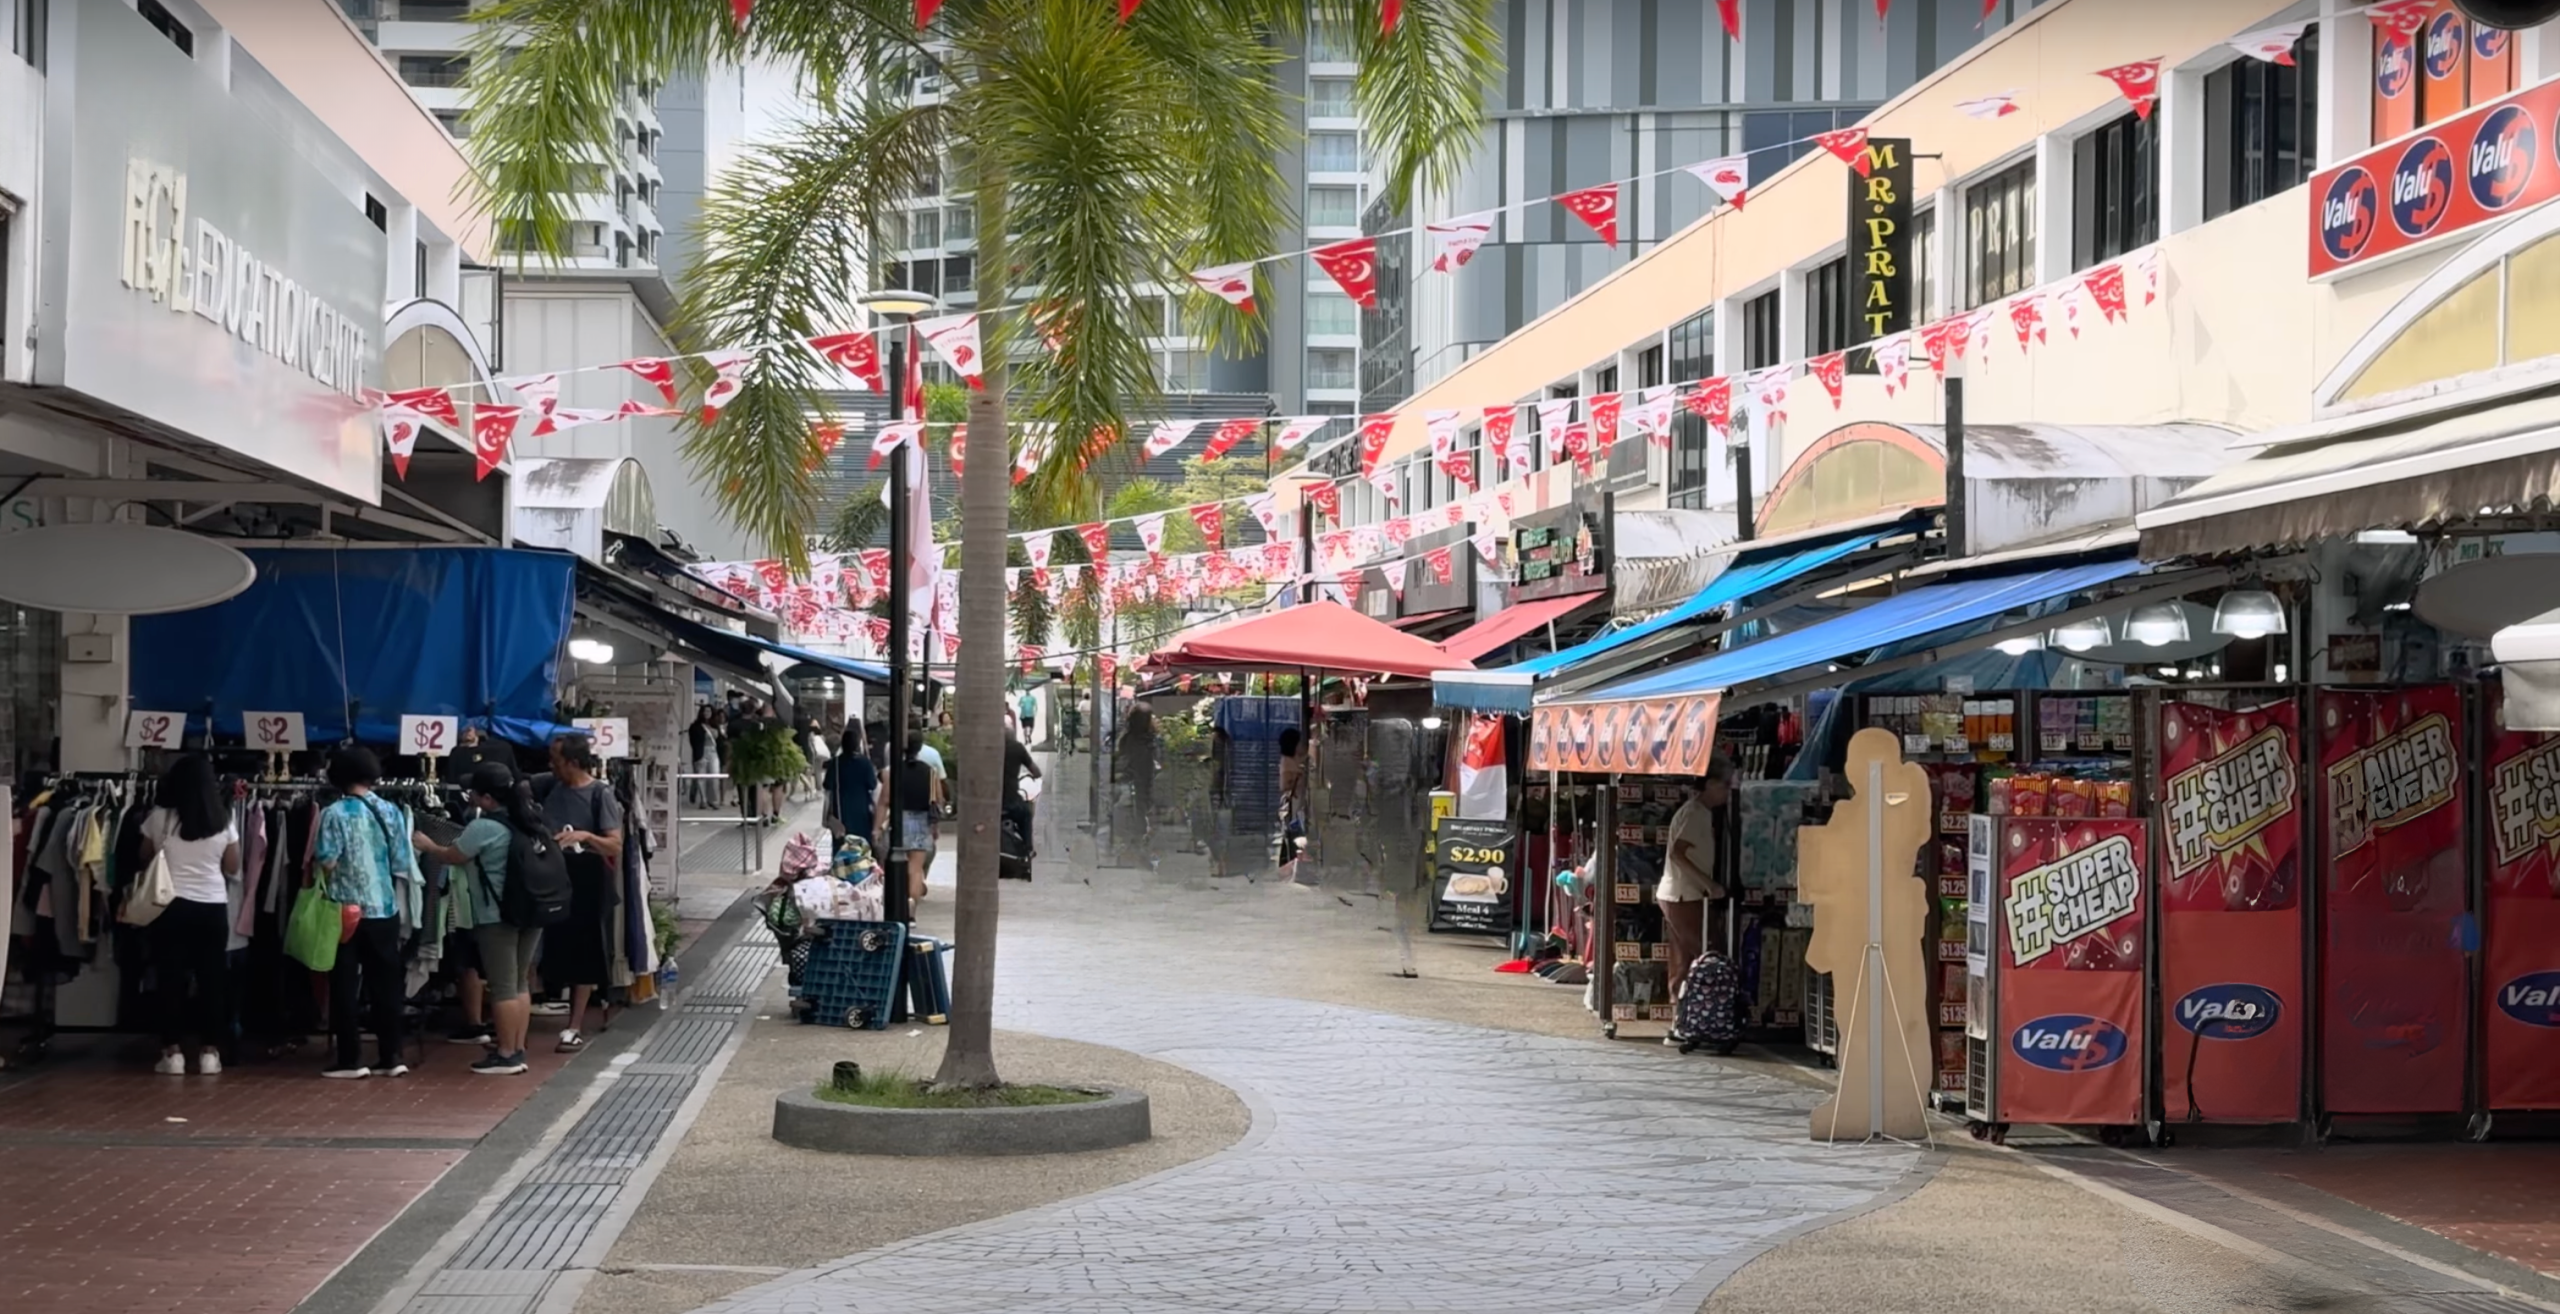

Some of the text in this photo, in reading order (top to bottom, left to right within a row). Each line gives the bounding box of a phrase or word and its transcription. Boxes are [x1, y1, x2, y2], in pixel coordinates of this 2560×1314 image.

[139, 715, 171, 744] $2
[257, 716, 290, 745] $2
[414, 720, 444, 749] $2
[2207, 770, 2288, 834] CHEAP
[1942, 814, 1968, 830] $2.25
[1451, 845, 1506, 864] $2.90
[1941, 879, 1967, 894] $1.25
[1456, 903, 1481, 914] Meal
[2051, 872, 2135, 938] CHEAP
[1941, 942, 1967, 958] $1.35
[1942, 1006, 1967, 1022] $1.35
[1941, 1073, 1967, 1088] $1.35
